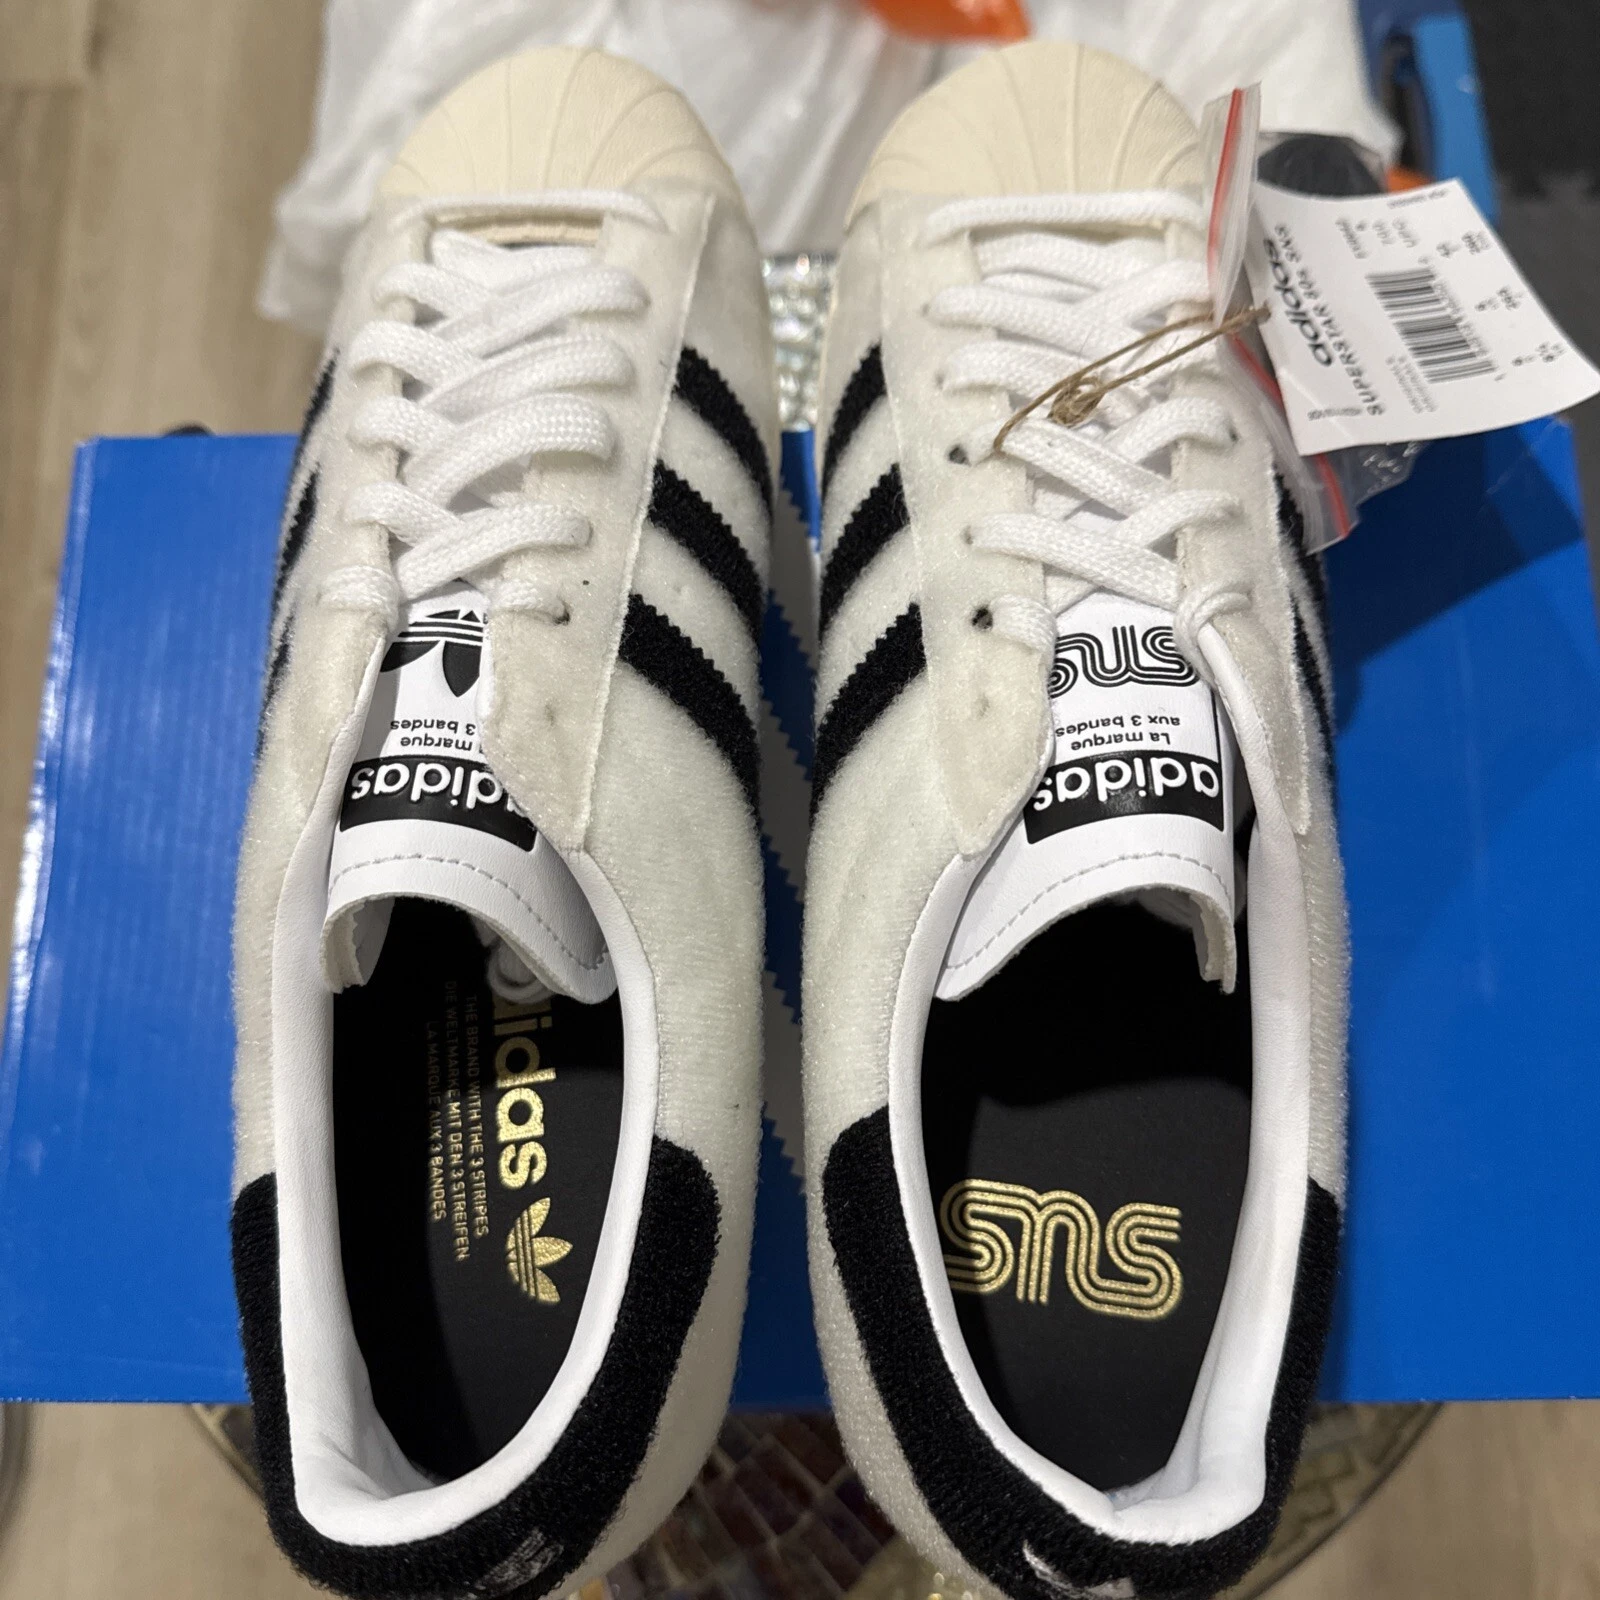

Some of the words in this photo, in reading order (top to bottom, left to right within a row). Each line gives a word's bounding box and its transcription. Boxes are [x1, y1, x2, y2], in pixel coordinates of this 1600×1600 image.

[1263, 238, 1335, 367] adidas
[1315, 302, 1386, 416] SUPERSTAR
[390, 719, 458, 734] bandes
[465, 723, 476, 736] 3
[1055, 715, 1125, 737] bandes
[1131, 715, 1142, 726] 3
[1148, 715, 1180, 726] aux
[400, 734, 473, 752] marque
[1071, 732, 1143, 751] marque
[1149, 732, 1171, 745] La
[351, 763, 529, 817] didas
[1033, 757, 1219, 811] adidas
[464, 994, 478, 1023] THE
[445, 1007, 461, 1099] WELTMARKE
[466, 1027, 480, 1077] BRAND
[427, 1042, 442, 1105] MARQUE
[448, 1102, 461, 1128] MIT
[467, 1081, 482, 1120] WITH
[429, 1110, 443, 1140] AUX
[469, 1123, 483, 1153] THE
[430, 1143, 444, 1152] 3
[449, 1132, 463, 1165] DEN
[451, 1169, 465, 1179] 3
[472, 1158, 485, 1168] 3
[429, 1156, 446, 1222] BANDES
[472, 1171, 489, 1238] STRIPES
[451, 1181, 470, 1261] STREIFEN
